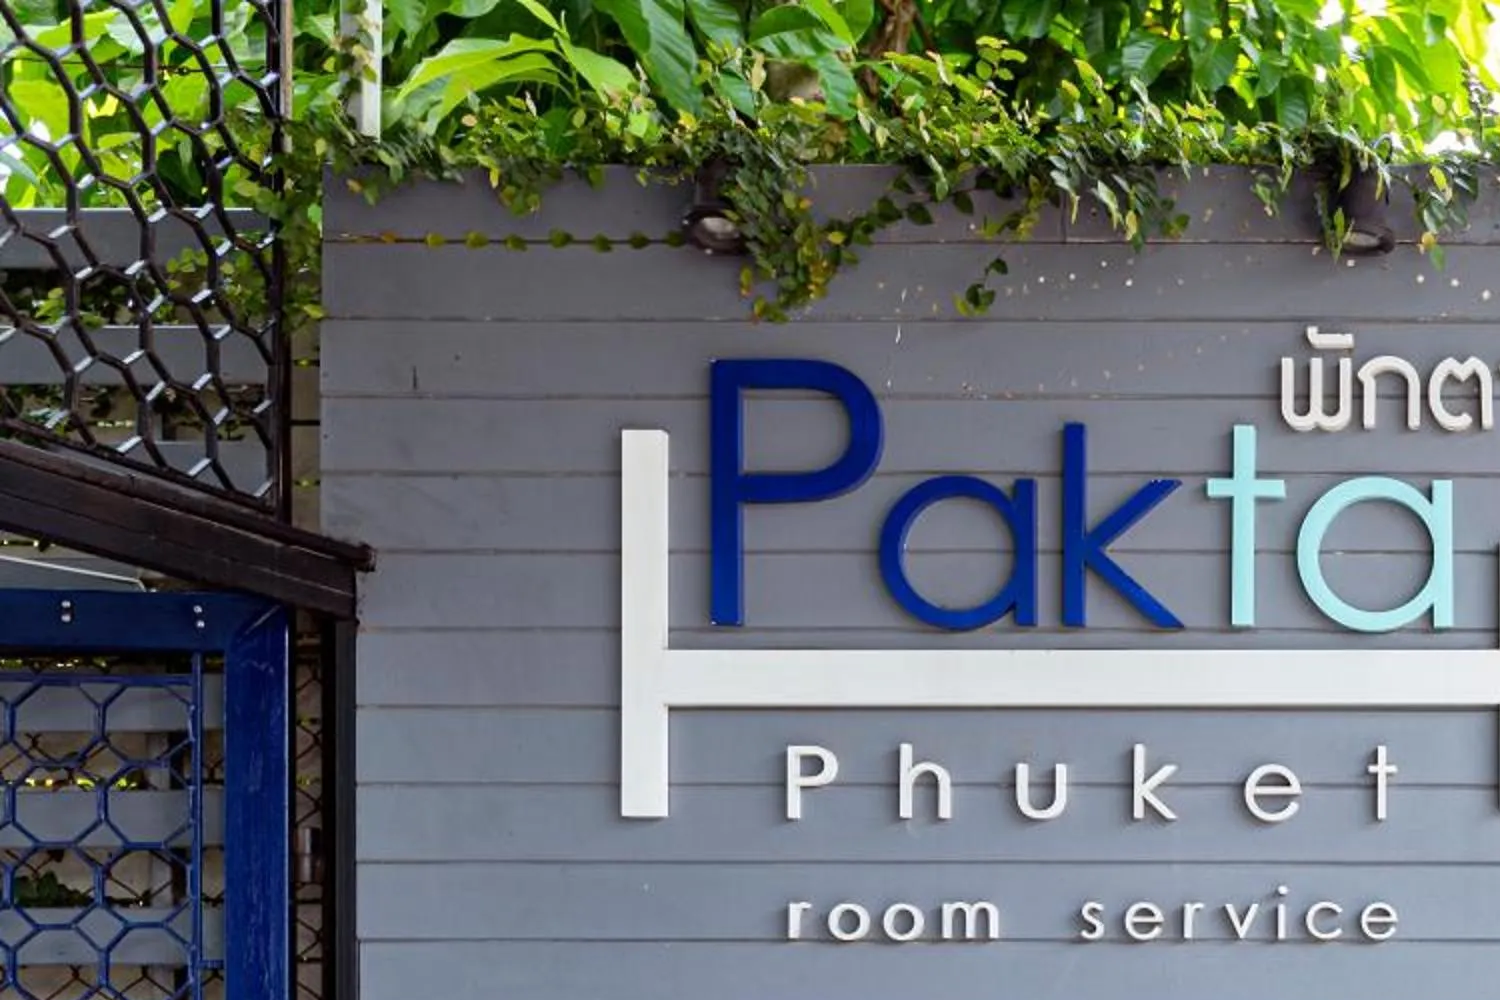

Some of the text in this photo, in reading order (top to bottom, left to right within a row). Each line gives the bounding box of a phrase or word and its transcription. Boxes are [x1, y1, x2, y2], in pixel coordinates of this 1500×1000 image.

[710, 358, 1453, 632] Pakta
[786, 743, 1397, 822] Phuket
[788, 885, 1399, 940] room service
